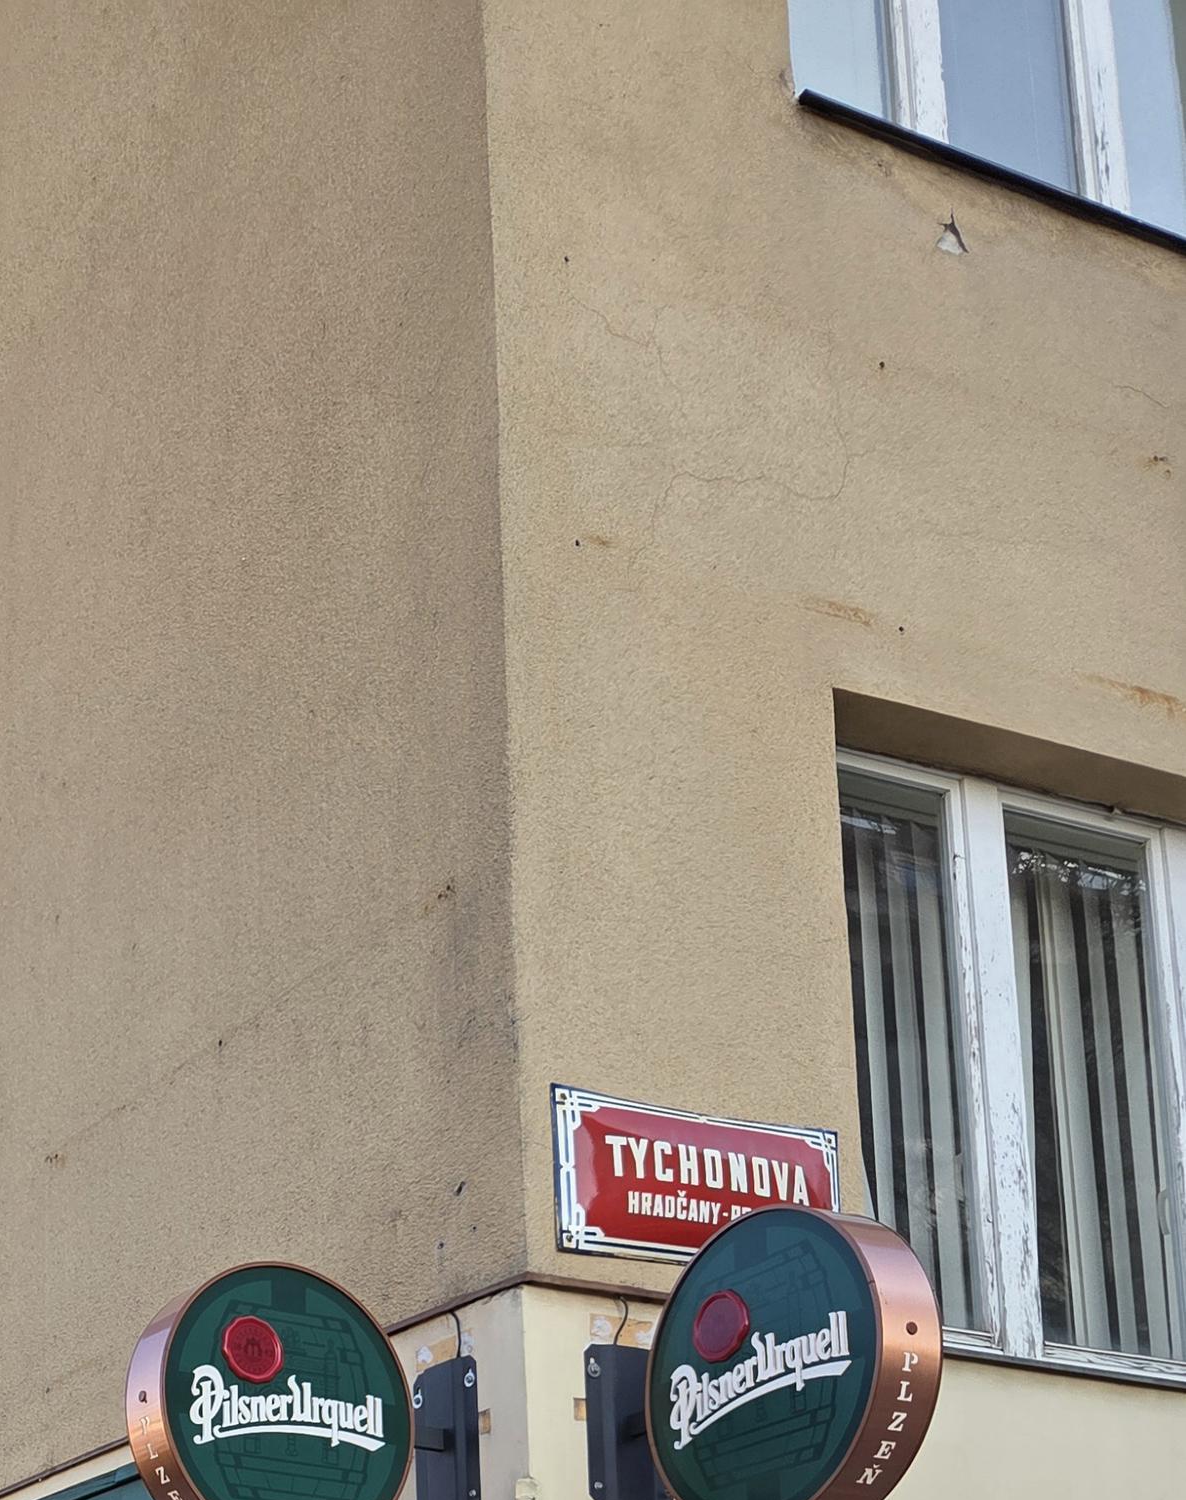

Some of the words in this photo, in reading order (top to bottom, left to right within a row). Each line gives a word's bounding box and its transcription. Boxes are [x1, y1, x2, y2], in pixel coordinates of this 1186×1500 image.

[604, 1135, 810, 1206] TYCHONOVA
[189, 1364, 294, 1445] Pilsner
[287, 1374, 385, 1448] Urquell
[669, 1354, 759, 1450] Pilsner
[751, 1310, 851, 1391] Urquell
[856, 1352, 919, 1486] PLZEŇ
